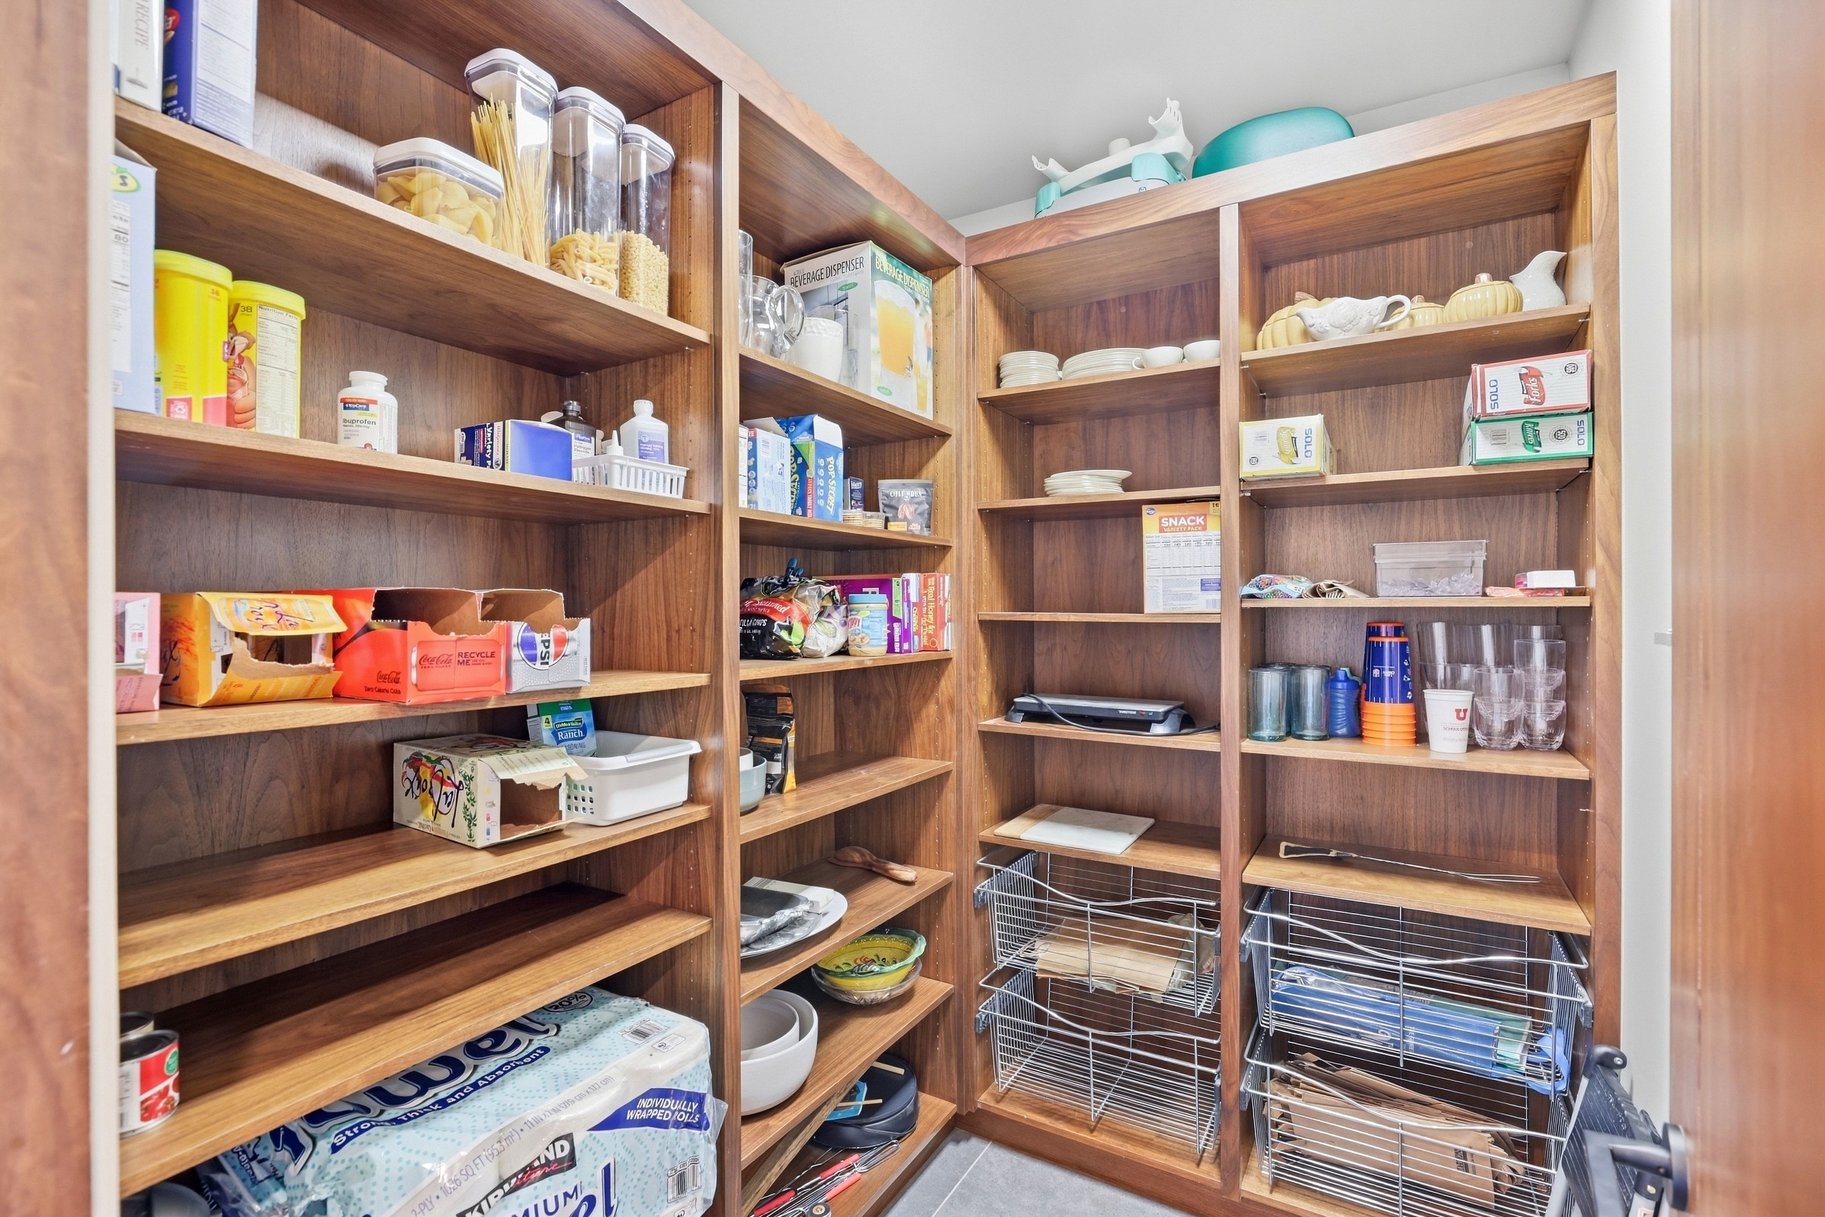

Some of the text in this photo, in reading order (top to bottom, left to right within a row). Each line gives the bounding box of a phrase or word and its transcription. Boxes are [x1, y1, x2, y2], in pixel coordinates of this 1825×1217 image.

[790, 268, 825, 288] BEVERAGE
[826, 256, 865, 279] DISPENSER
[240, 305, 253, 313] 38
[1489, 379, 1499, 410] SOLO
[1528, 377, 1542, 403] Forks
[1577, 420, 1585, 446] SOLO
[1304, 428, 1312, 458] SOLO
[1161, 515, 1205, 527] SNACK
[457, 651, 496, 659] RECYCLE
[1454, 708, 1469, 721] U
[558, 729, 584, 740] Ranch
[397, 1102, 443, 1123] Thick
[446, 1085, 475, 1105] and
[477, 1047, 545, 1088] Absorbent
[636, 1098, 699, 1113] INDIVIDUALLY
[626, 1109, 672, 1121] WRAPPED
